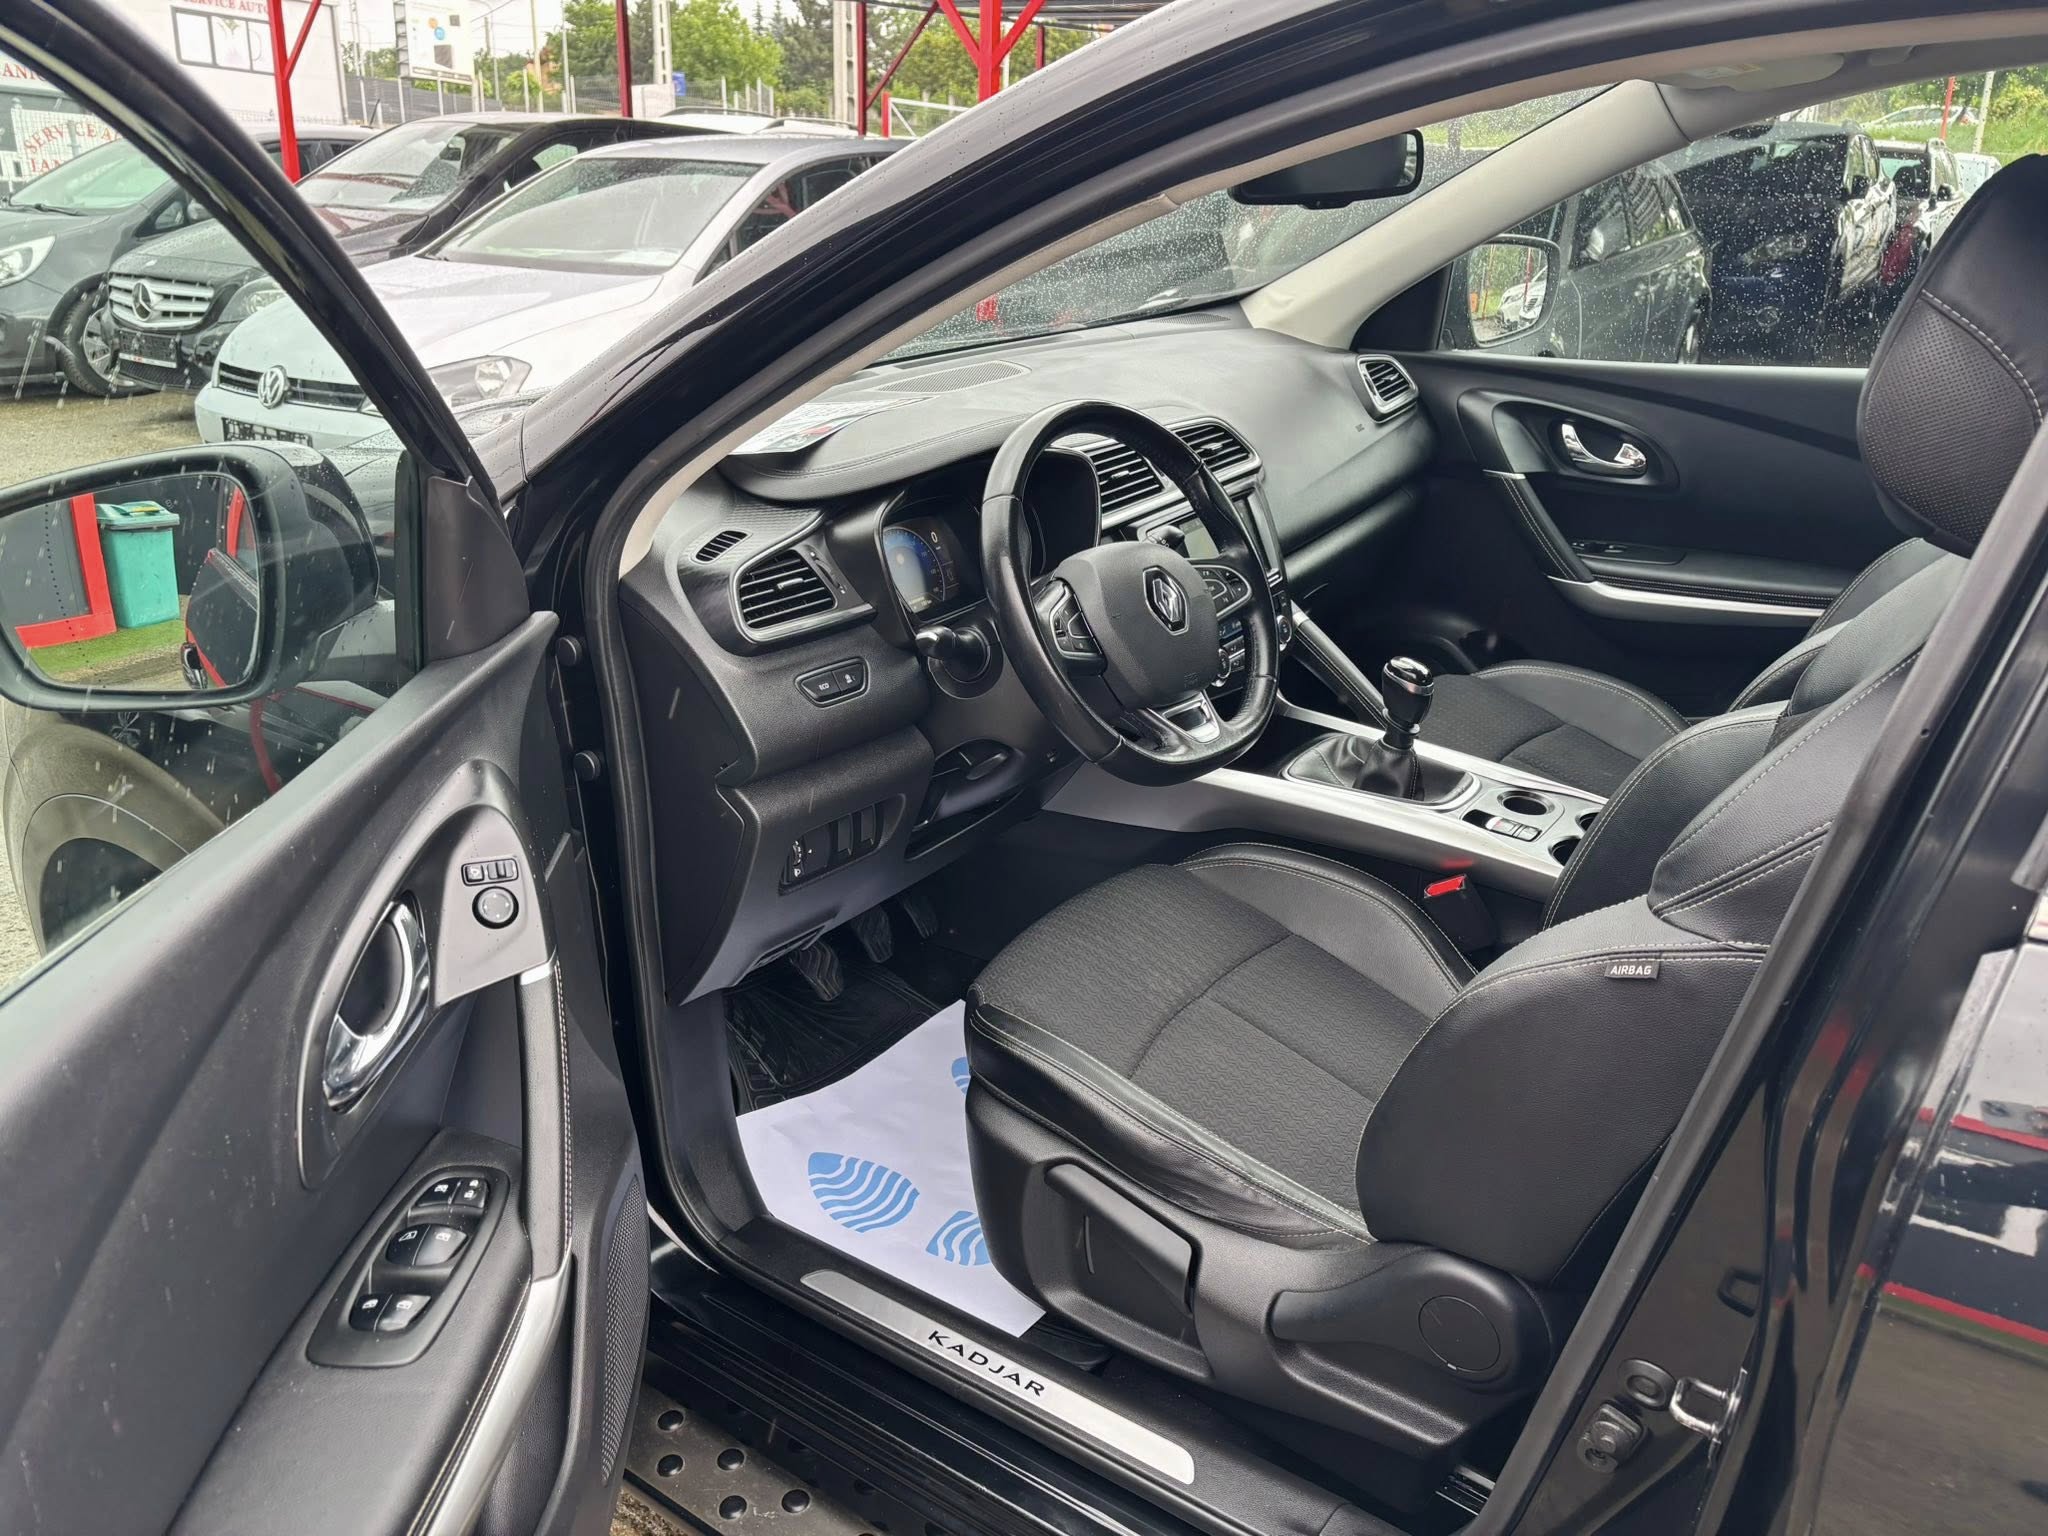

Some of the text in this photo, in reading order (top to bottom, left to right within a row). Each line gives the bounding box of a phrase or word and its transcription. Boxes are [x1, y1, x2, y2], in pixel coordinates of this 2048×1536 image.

[24, 121, 97, 154] SERVCE
[1610, 965, 1652, 975] AIRBAG
[928, 1330, 1045, 1397] KADJAR
